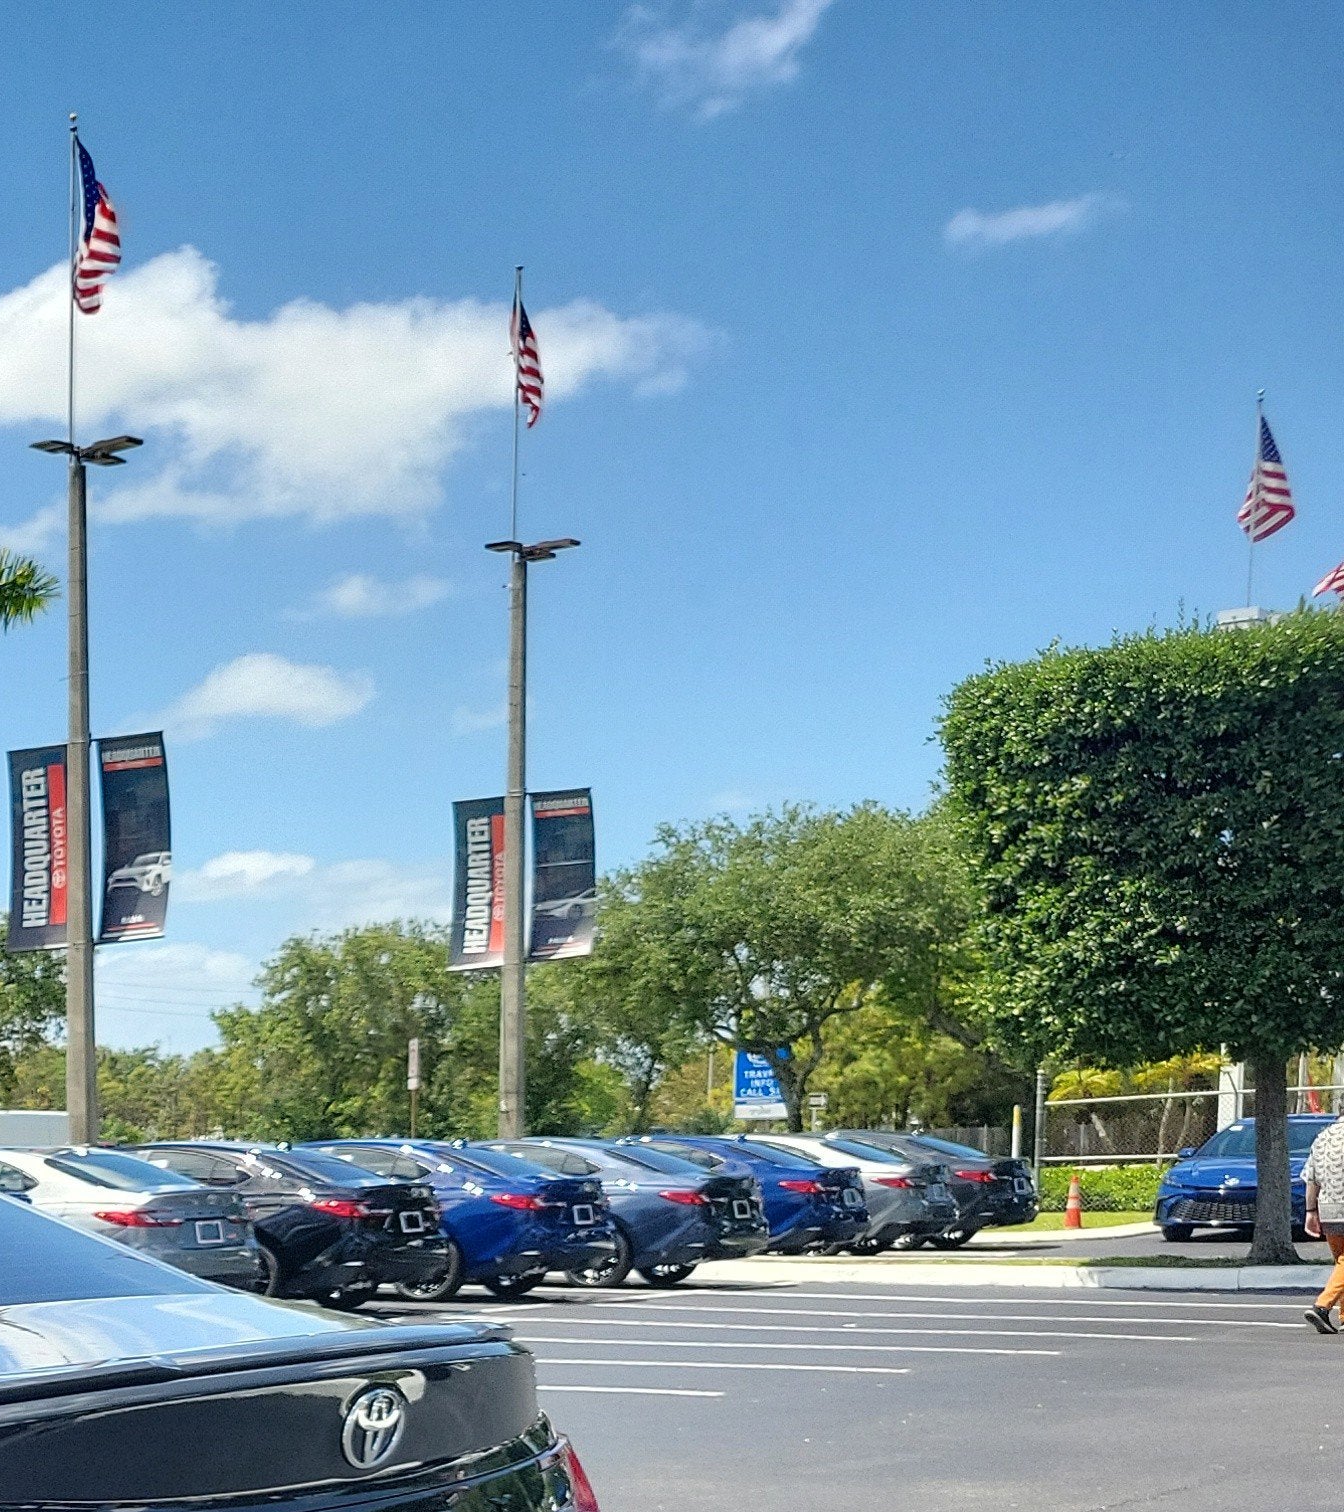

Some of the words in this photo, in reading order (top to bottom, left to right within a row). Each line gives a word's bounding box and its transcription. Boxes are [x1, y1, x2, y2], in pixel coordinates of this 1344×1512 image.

[21, 767, 51, 928] HEADQUARTER
[52, 807, 66, 870] TOYOTA
[463, 816, 493, 954] HEADQUARTER
